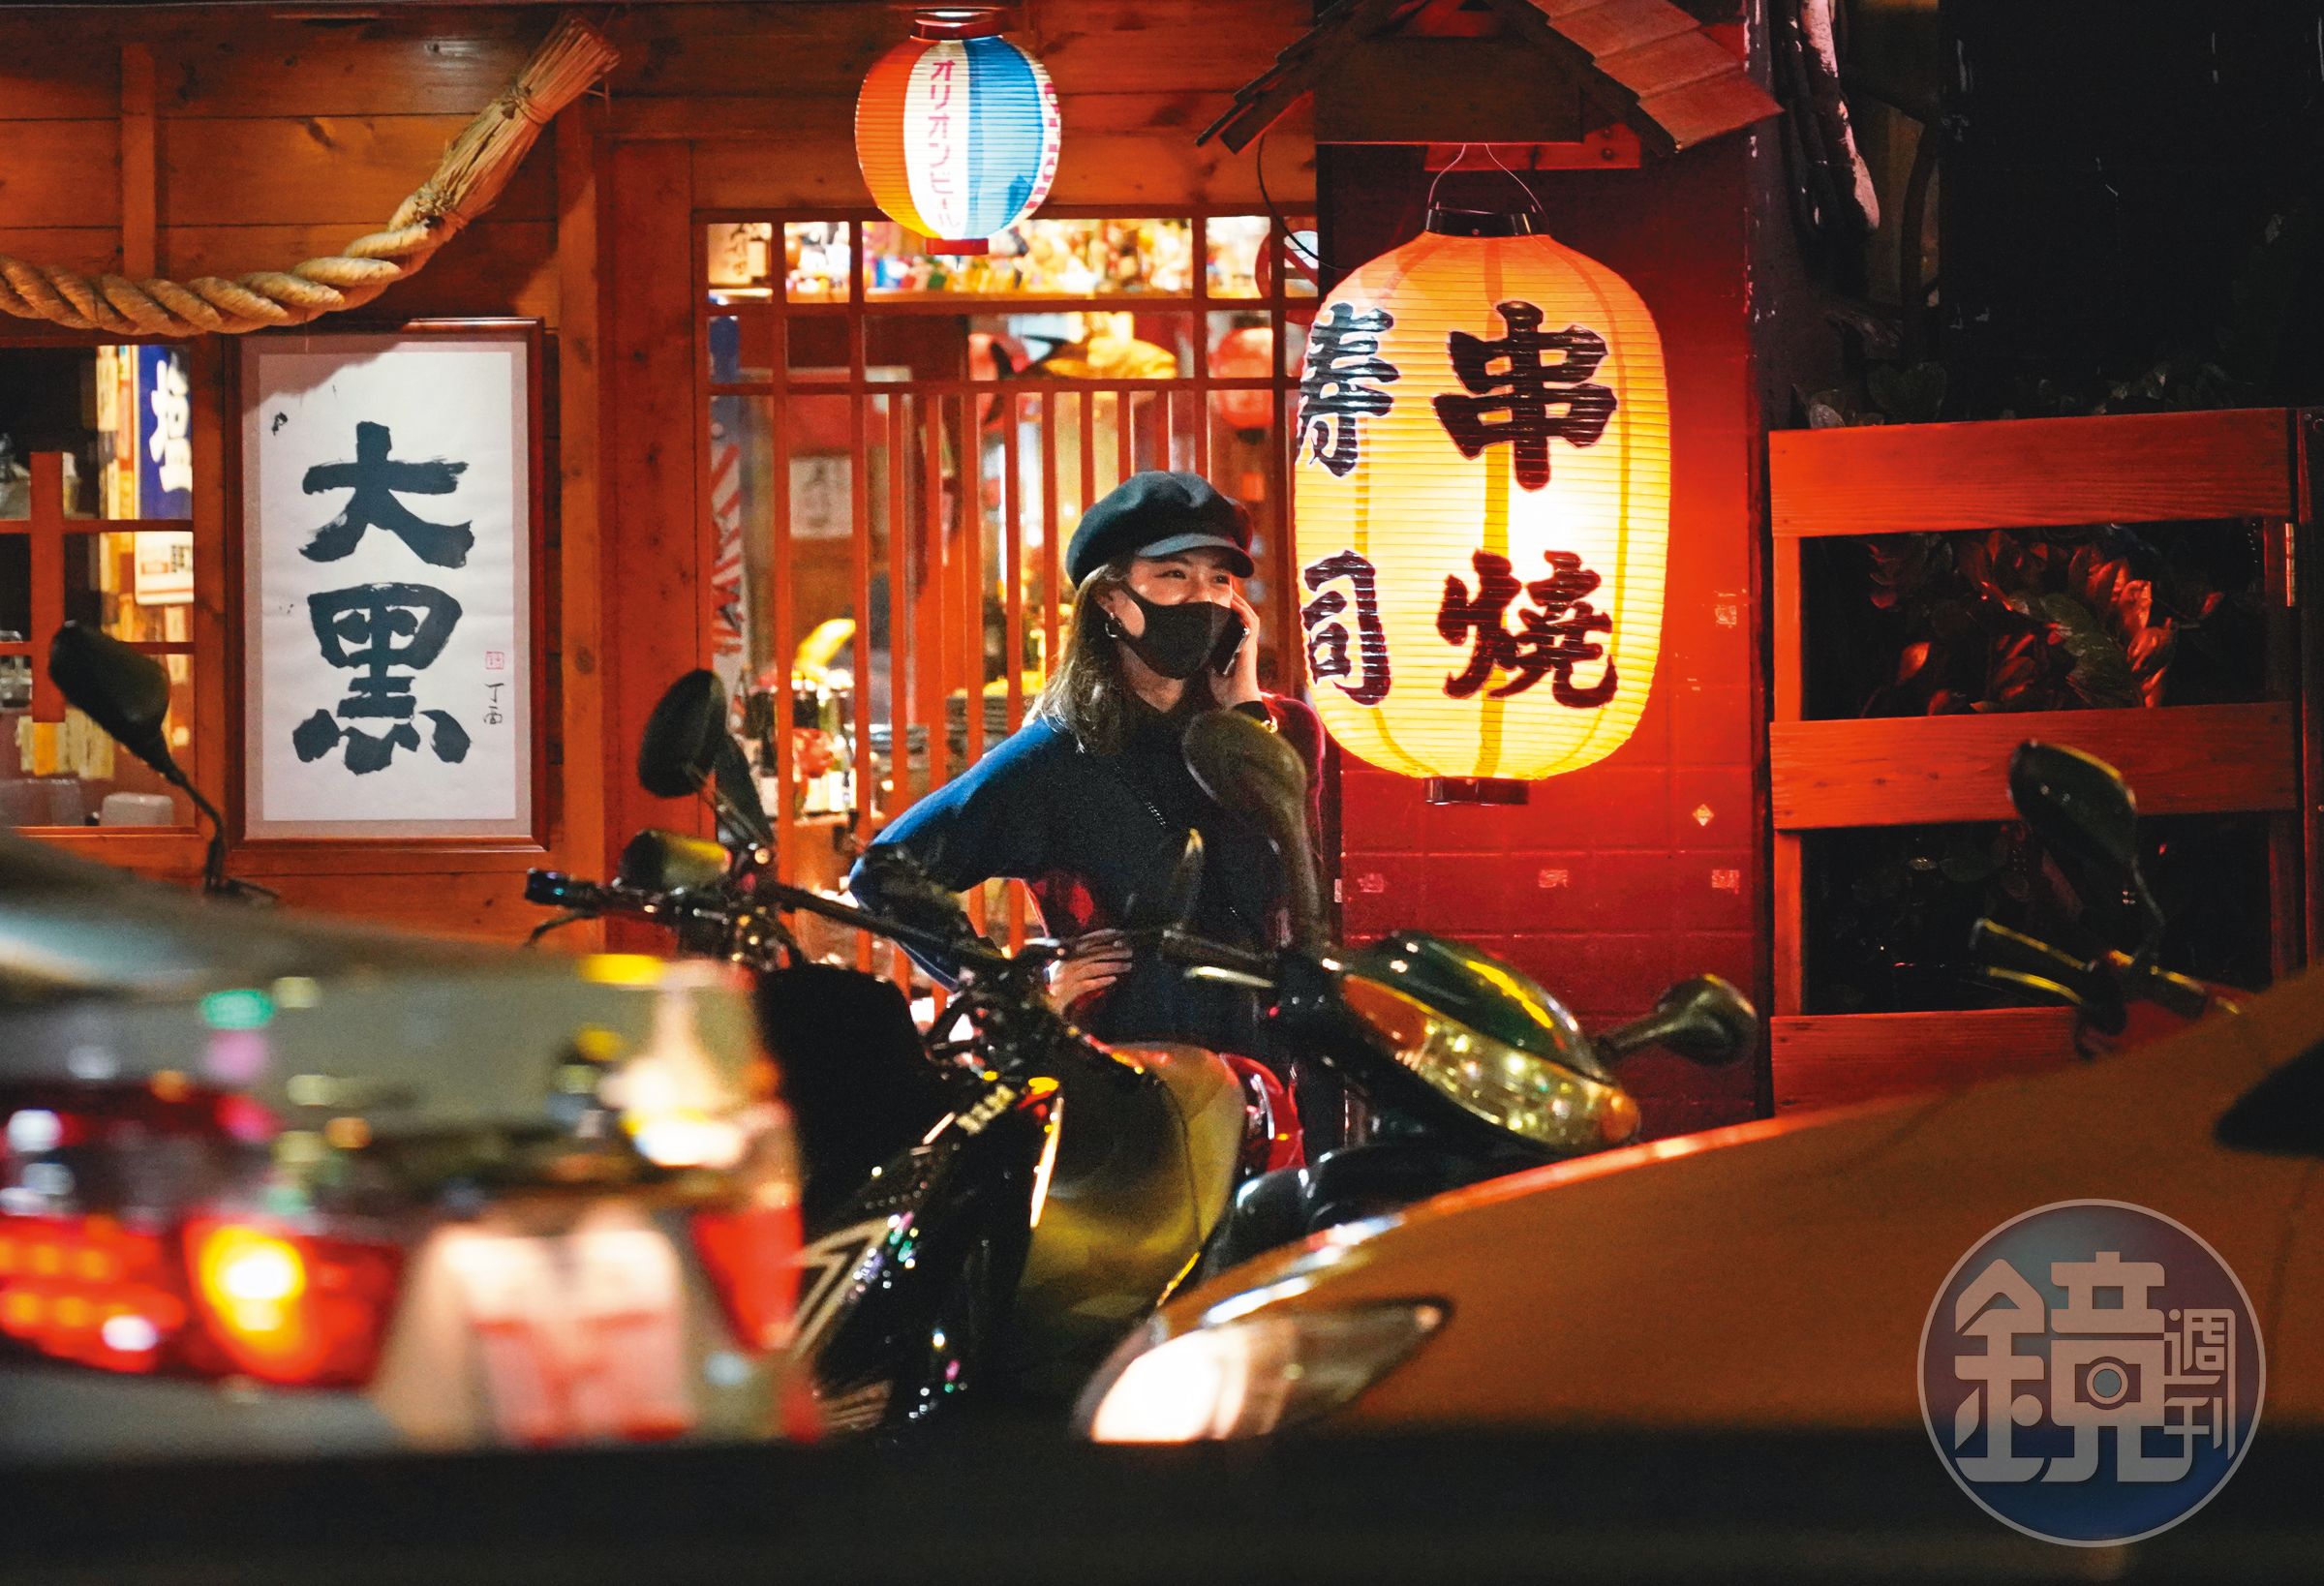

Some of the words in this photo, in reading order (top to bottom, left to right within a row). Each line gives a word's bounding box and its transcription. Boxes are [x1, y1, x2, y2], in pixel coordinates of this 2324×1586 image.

[928, 59, 961, 229] オリオンビール
[1432, 300, 1618, 709] 串燒
